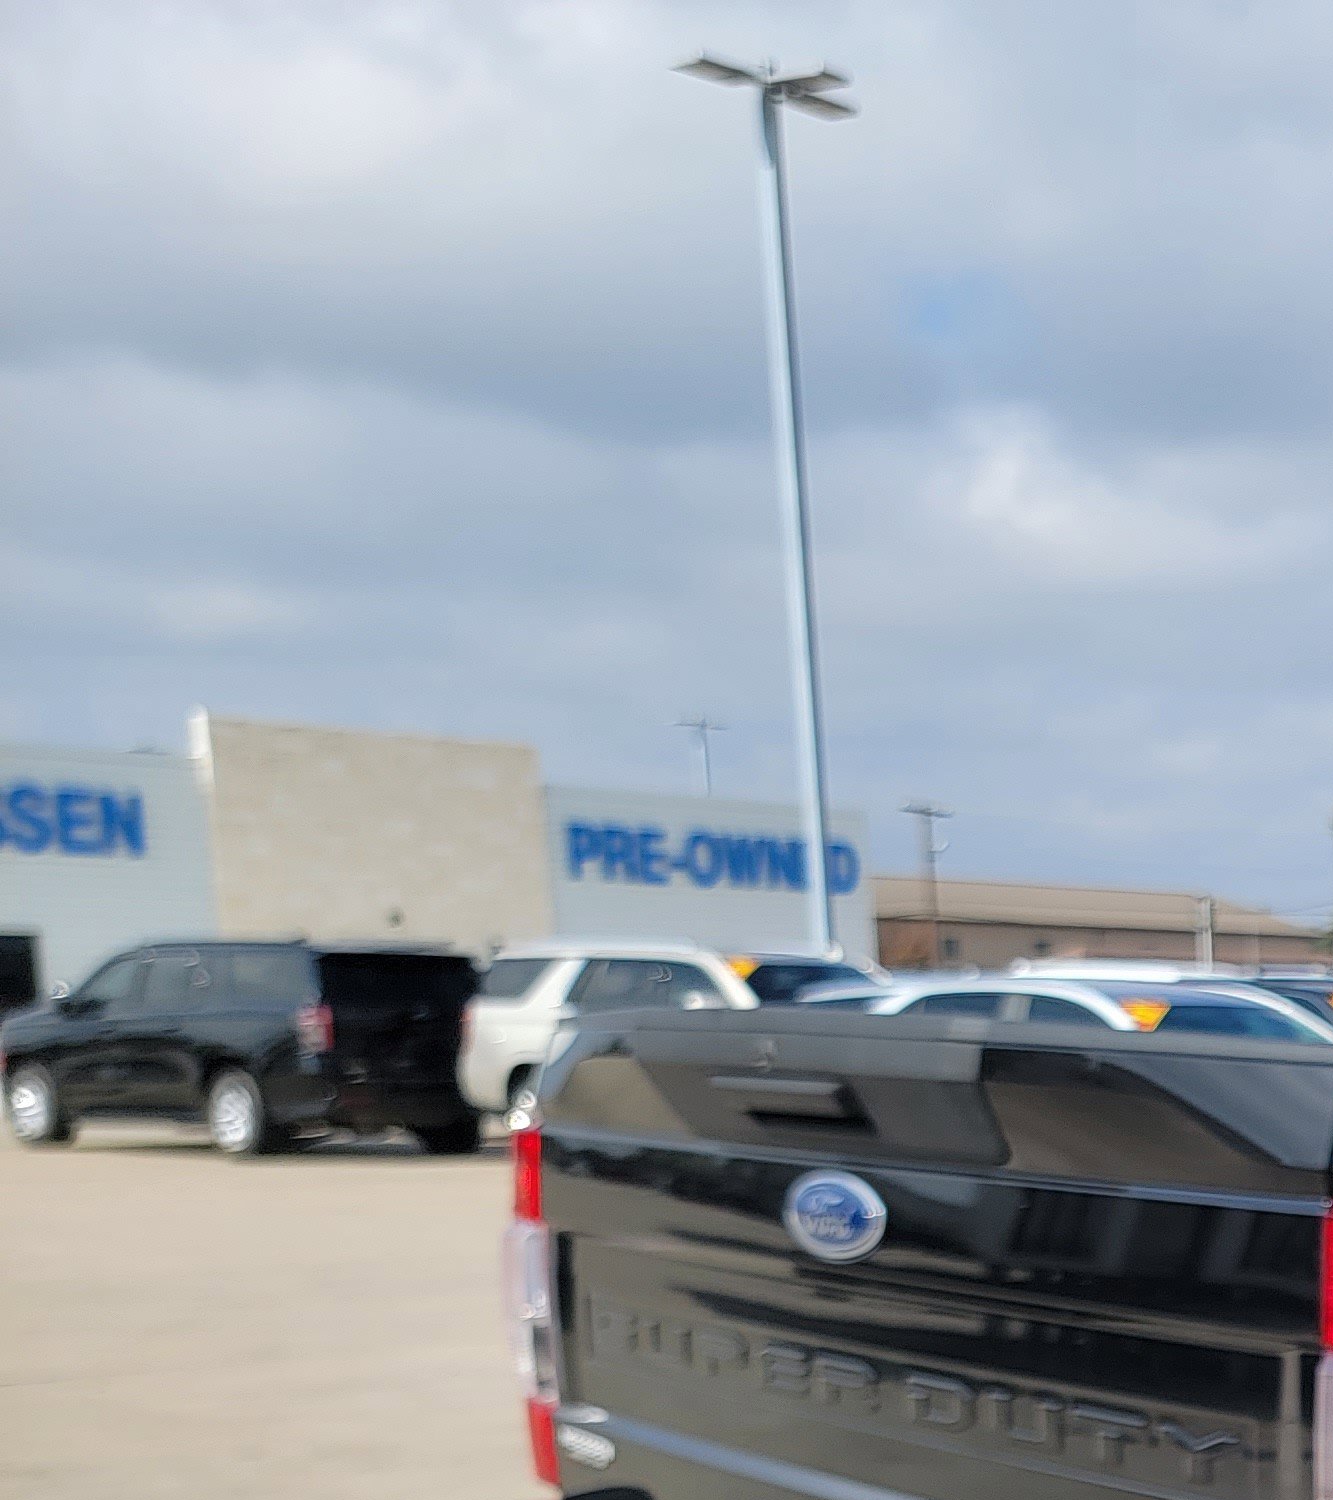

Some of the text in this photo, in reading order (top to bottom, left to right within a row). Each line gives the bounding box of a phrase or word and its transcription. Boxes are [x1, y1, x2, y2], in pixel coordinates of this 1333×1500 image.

[0, 784, 146, 857] SEN
[566, 823, 860, 895] PRE-OWND
[904, 1373, 1240, 1484] DUTY
